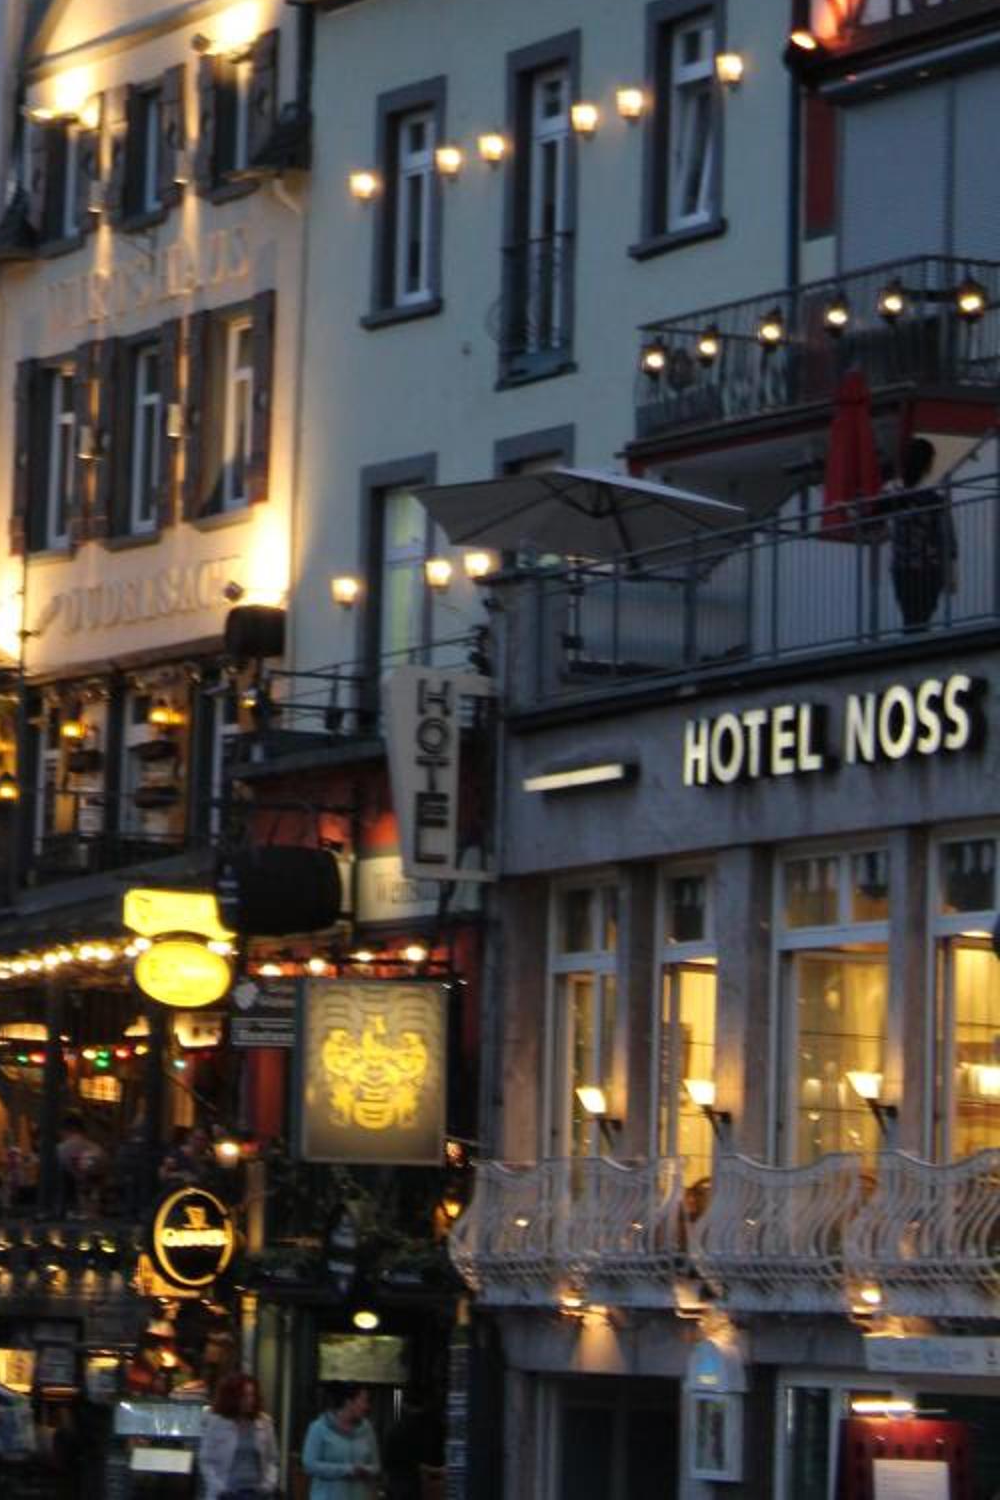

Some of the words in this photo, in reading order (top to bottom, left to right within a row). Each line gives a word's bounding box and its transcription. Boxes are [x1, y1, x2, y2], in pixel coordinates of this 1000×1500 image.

[415, 678, 451, 864] HOTEL
[683, 703, 822, 787] HOTEL
[845, 673, 971, 765] NOSS
